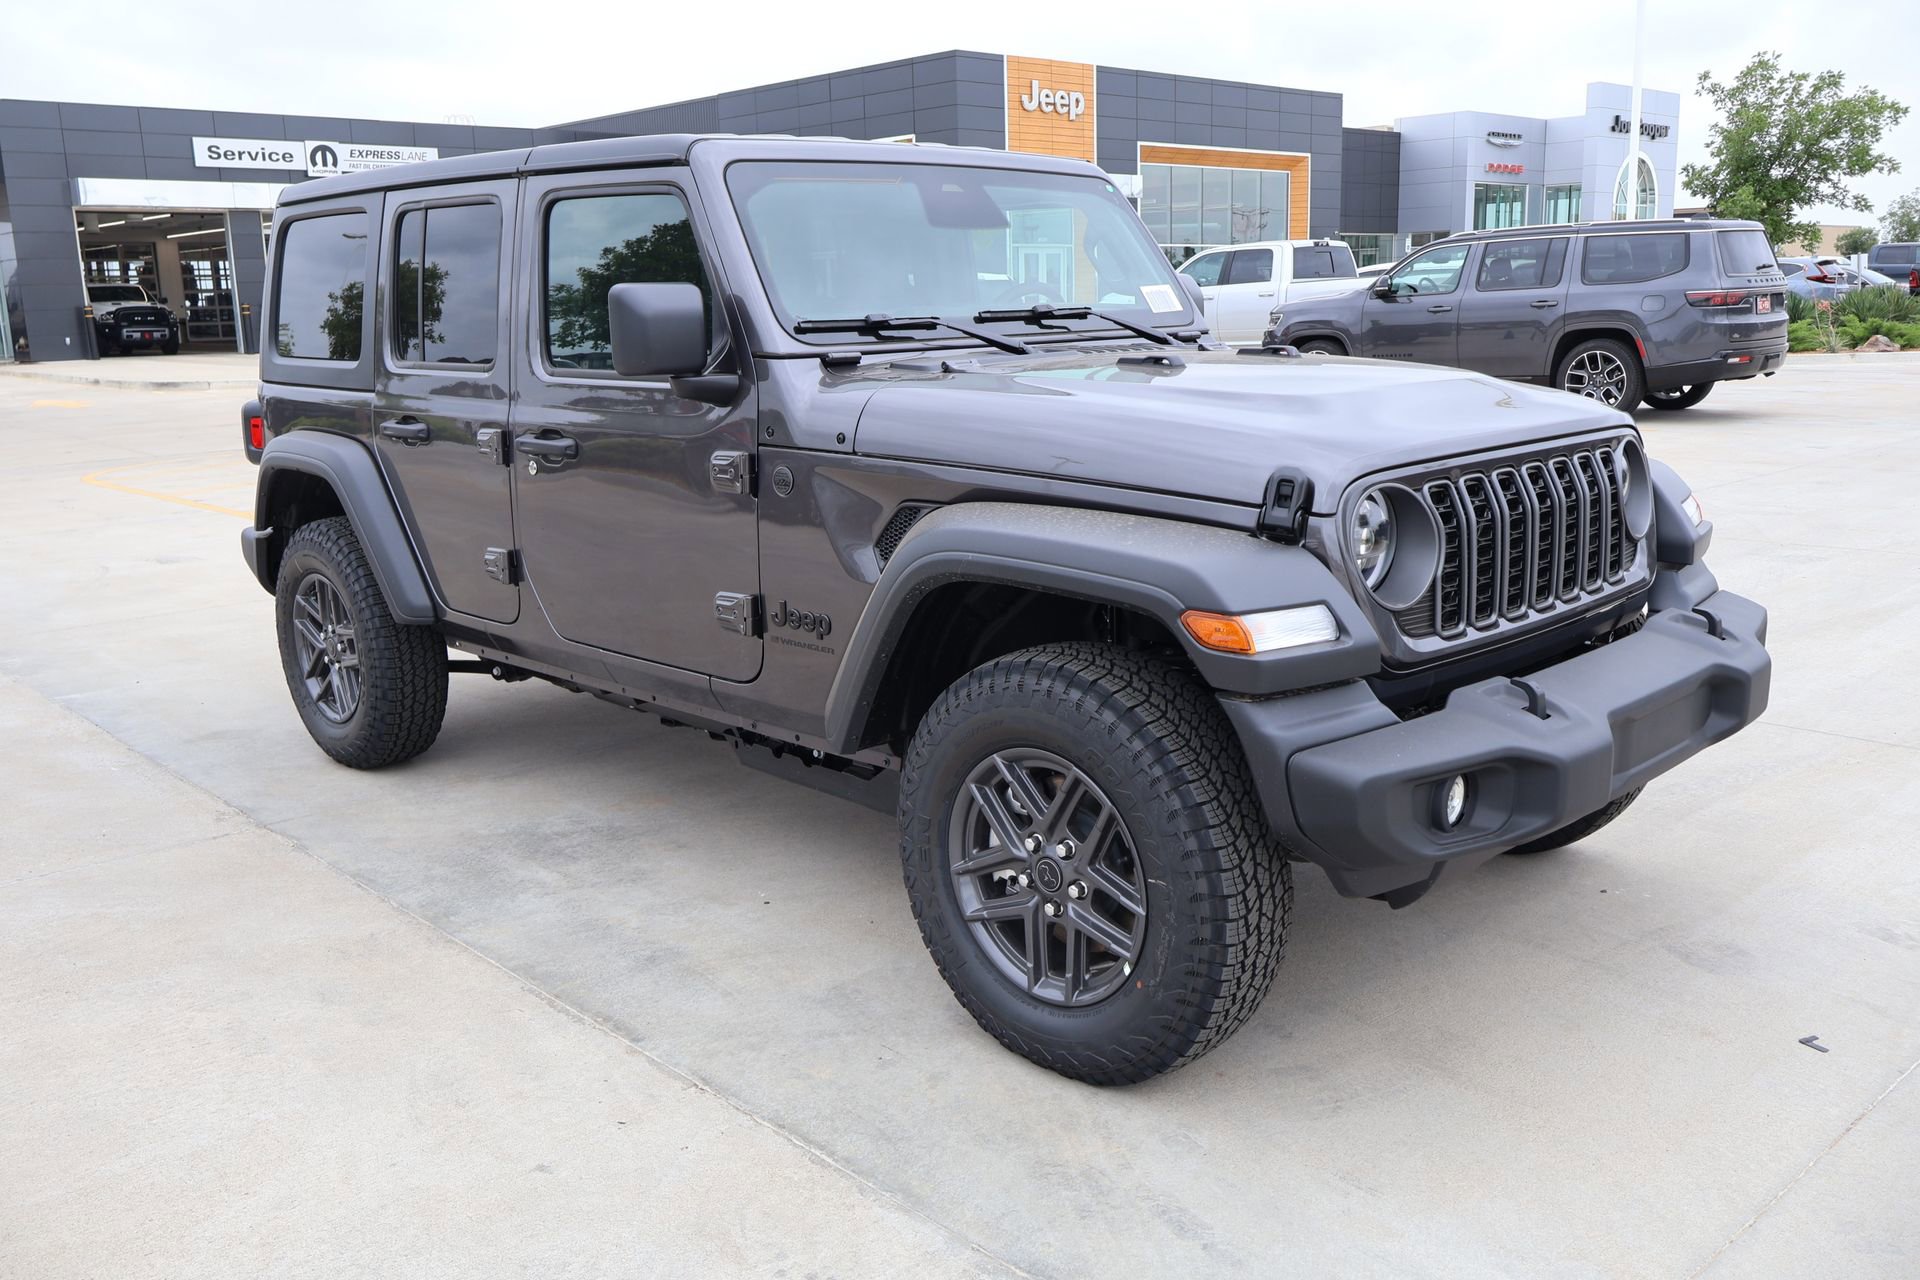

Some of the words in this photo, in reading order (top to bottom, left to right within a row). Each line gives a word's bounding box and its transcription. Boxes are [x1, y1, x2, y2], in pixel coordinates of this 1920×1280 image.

[1021, 80, 1085, 121] Jeep
[207, 144, 294, 163] Service
[1487, 162, 1525, 174] DODGE
[771, 600, 832, 641] Jeep
[780, 636, 836, 656] WRANGLER
